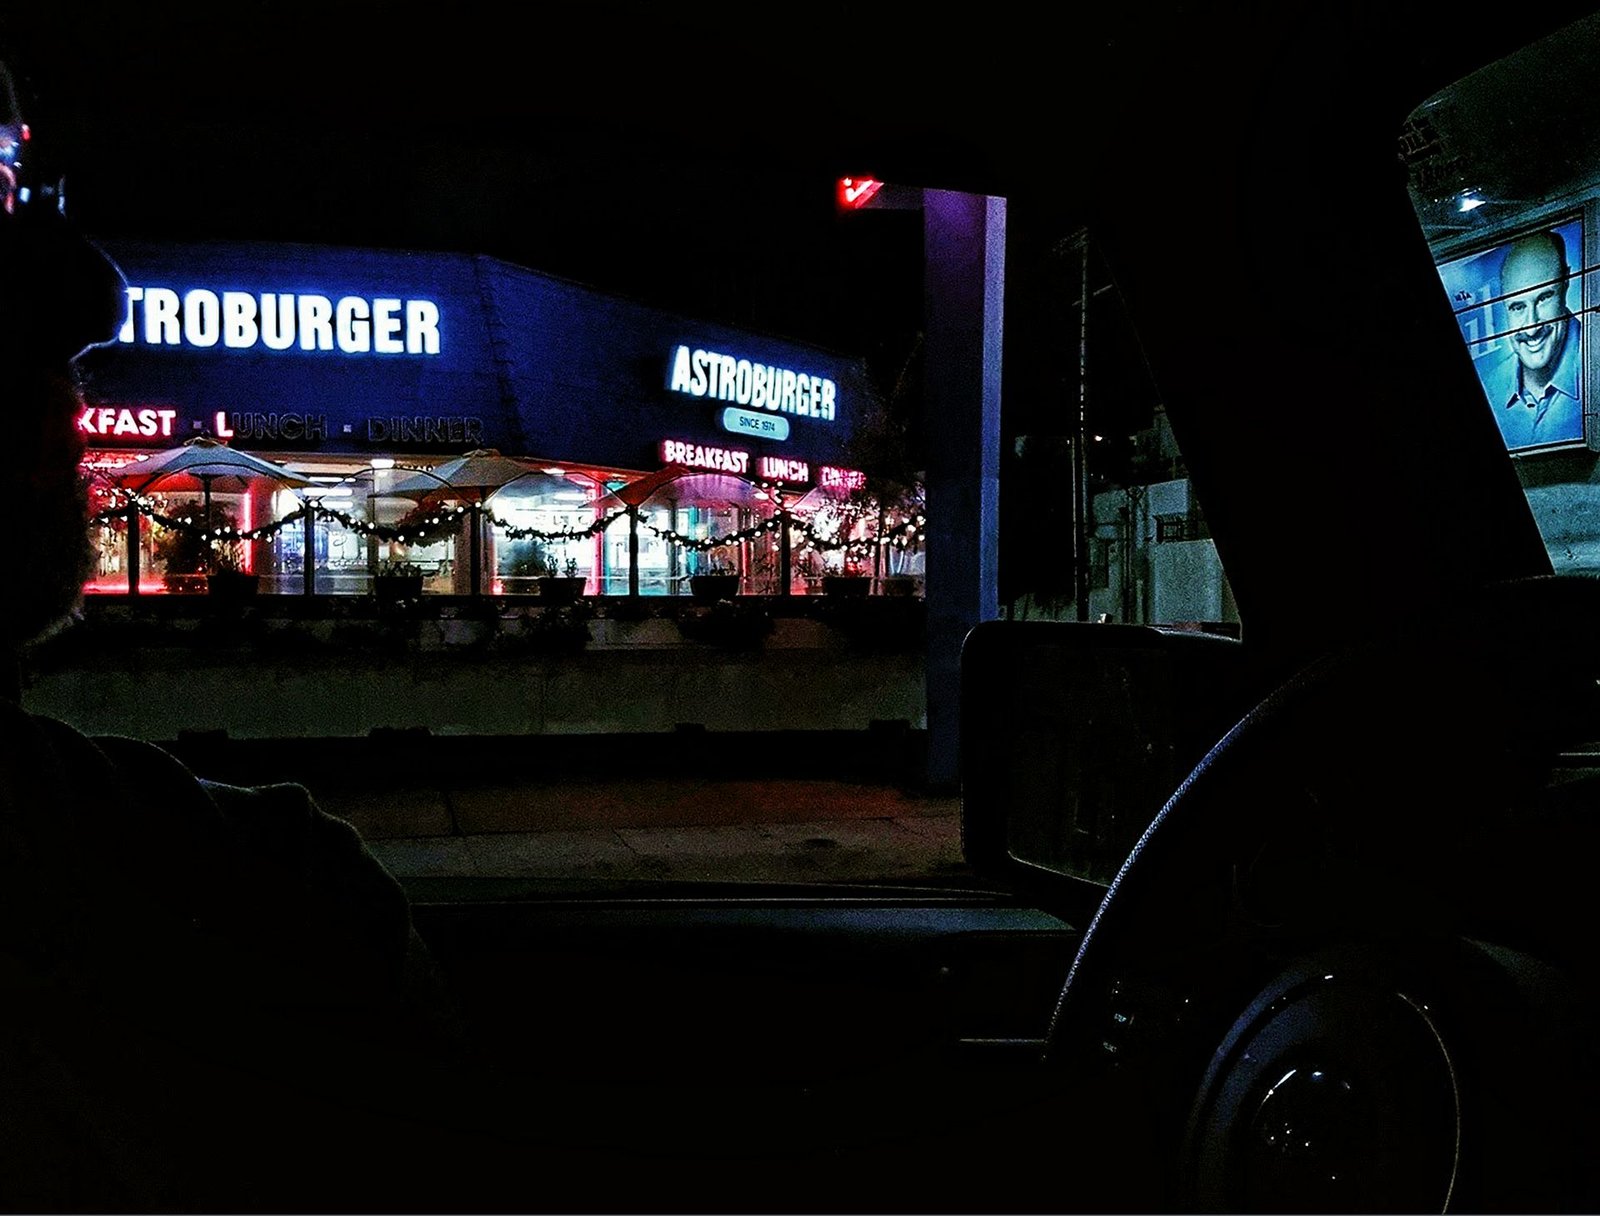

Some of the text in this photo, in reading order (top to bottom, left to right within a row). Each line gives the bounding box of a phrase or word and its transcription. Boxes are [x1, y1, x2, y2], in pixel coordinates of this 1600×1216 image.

[672, 345, 836, 421] ASTROBURGER
[216, 412, 328, 440] LUNCH
[368, 416, 485, 443] DINNER
[739, 416, 775, 431] SINCE 1974
[664, 440, 748, 473] BREAKFAST
[763, 457, 808, 482] LUNCH
